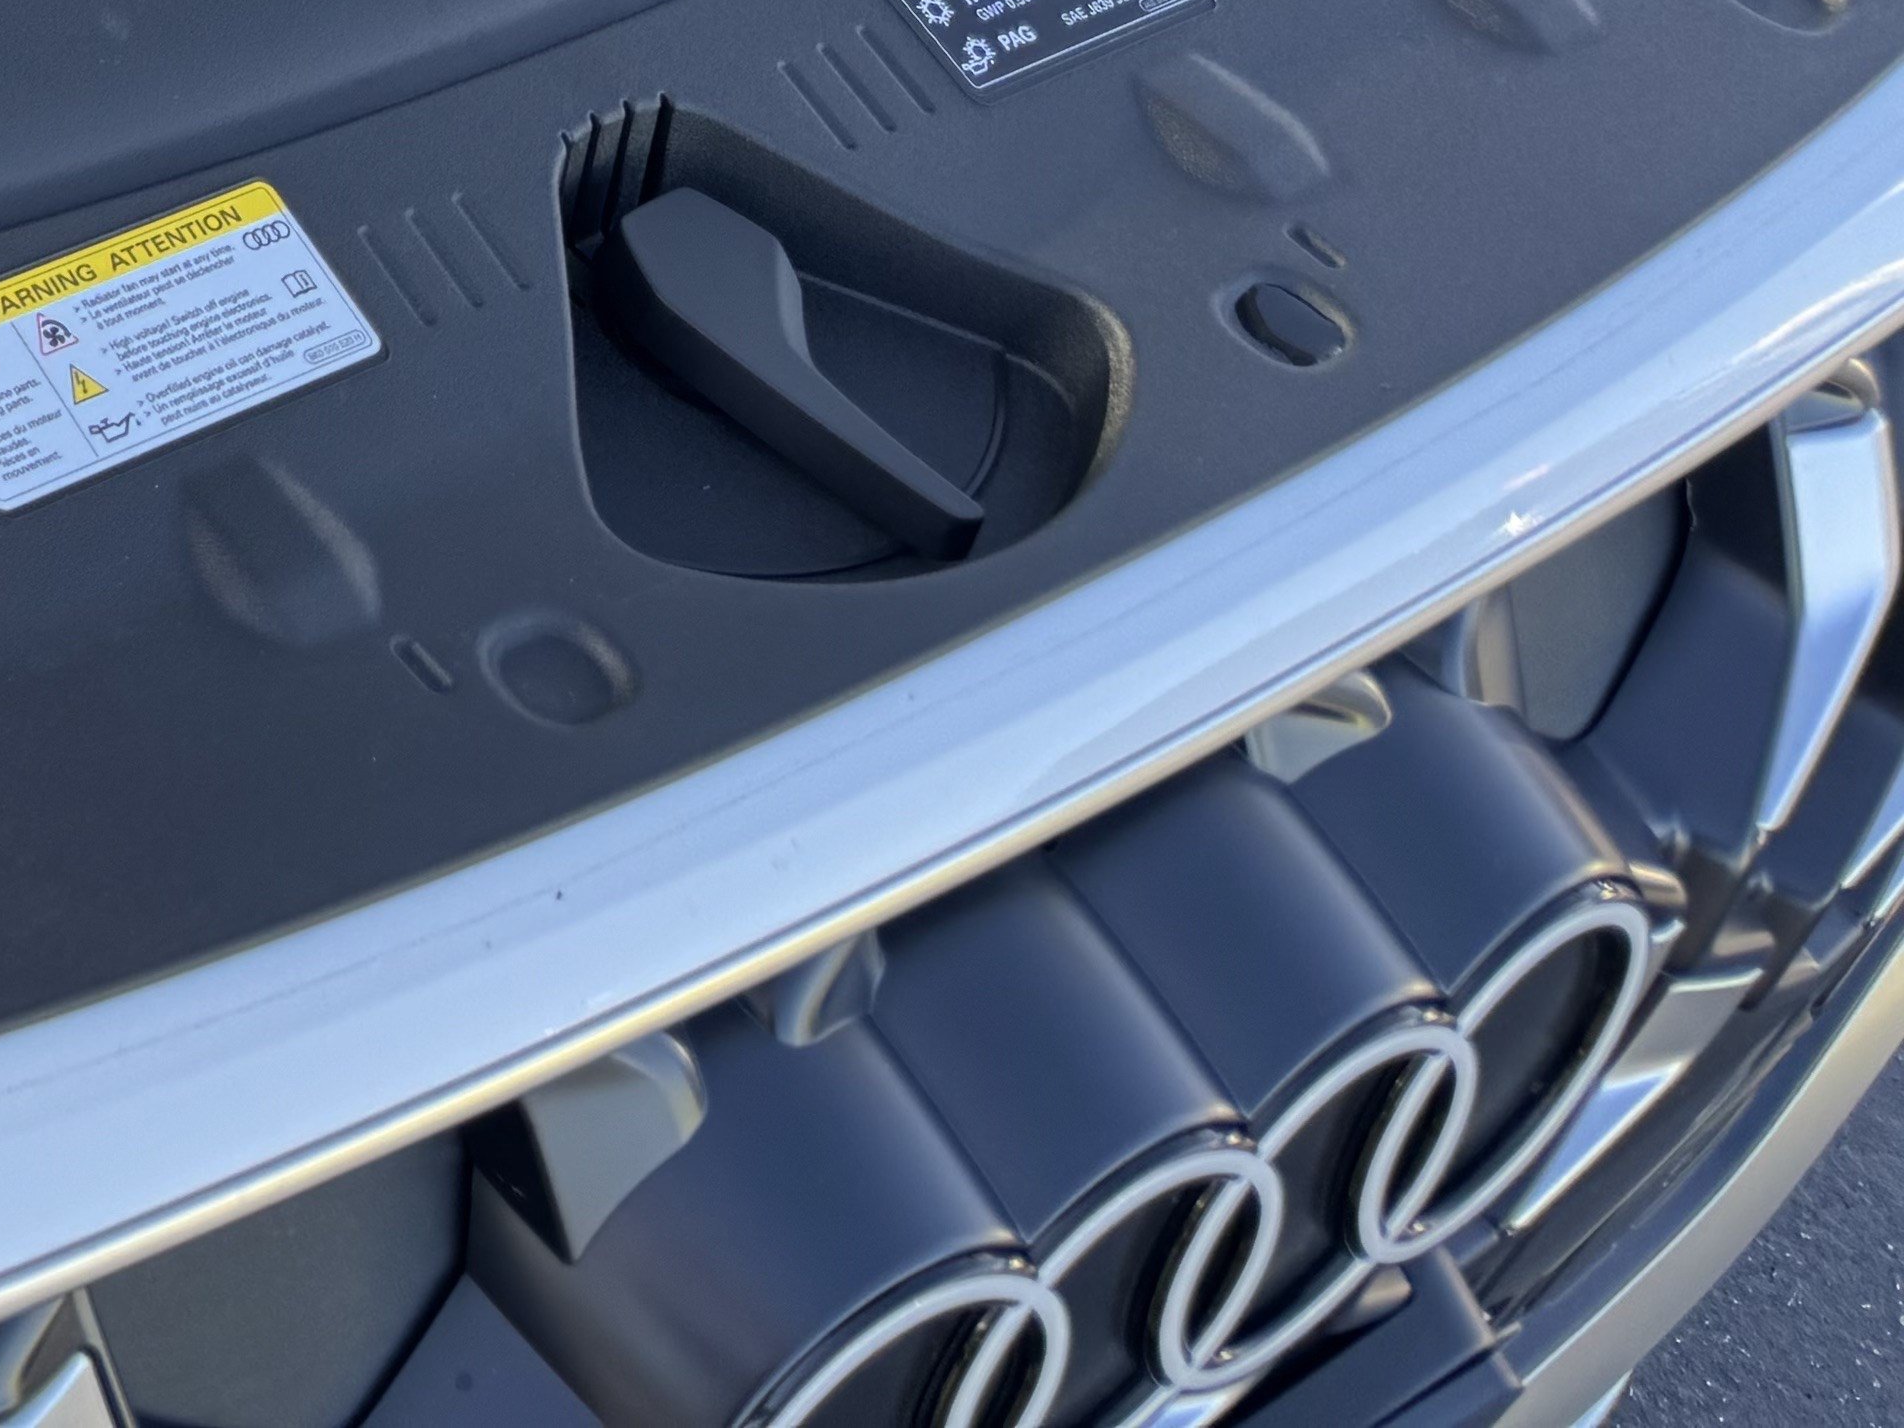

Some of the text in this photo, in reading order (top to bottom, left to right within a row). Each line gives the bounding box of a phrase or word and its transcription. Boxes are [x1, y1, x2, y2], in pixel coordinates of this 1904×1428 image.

[976, 2, 1007, 20] GWP
[1060, 7, 1087, 25] SAE
[997, 25, 1037, 49] PAG
[105, 206, 241, 269] ATTENTION
[83, 242, 234, 308] Radiator fan may start at any time.
[109, 289, 249, 351] High voltage! Switch off engine
[117, 292, 270, 360] before touching engine electronics.
[146, 378, 190, 402] Overfilled
[192, 365, 224, 385] engine
[222, 358, 237, 370] oil
[237, 352, 255, 365] can
[255, 336, 292, 358] damage
[292, 320, 330, 342] catalyst.
[13, 376, 40, 394] parts.
[4, 393, 33, 412] parts.
[12, 421, 26, 434] du
[28, 409, 61, 428] moteur
